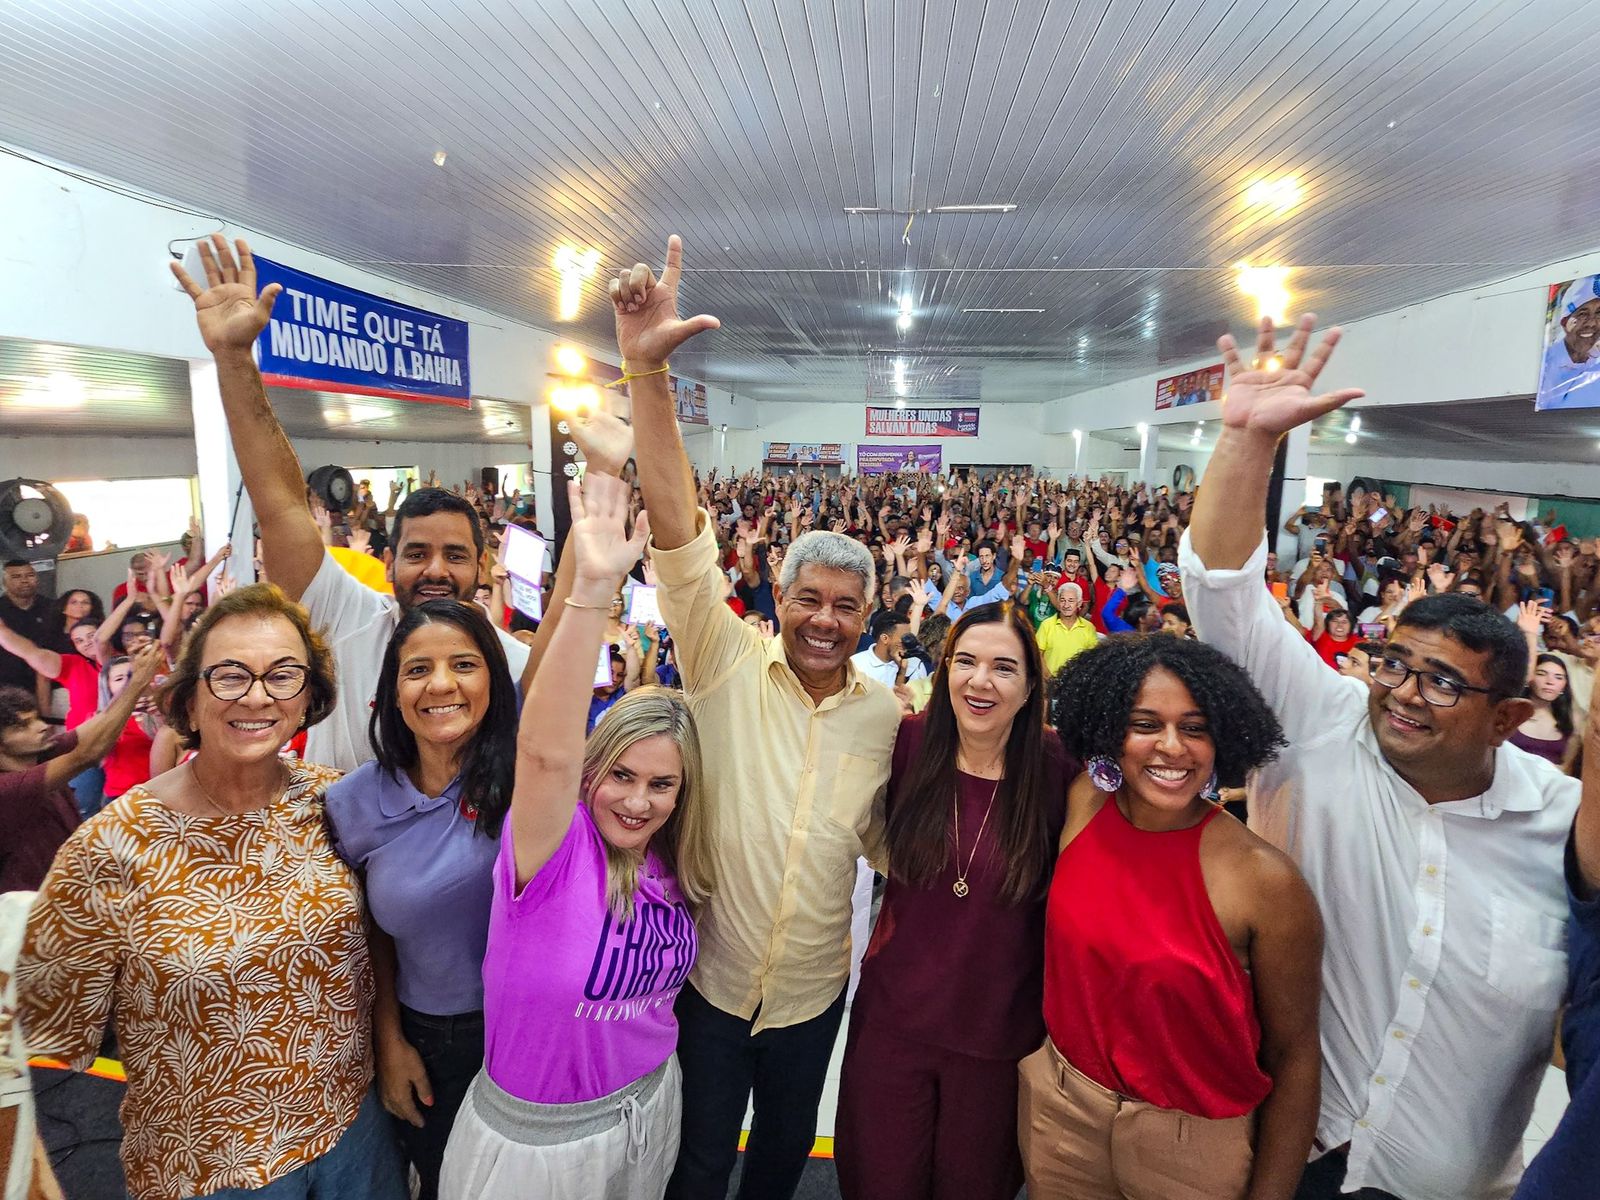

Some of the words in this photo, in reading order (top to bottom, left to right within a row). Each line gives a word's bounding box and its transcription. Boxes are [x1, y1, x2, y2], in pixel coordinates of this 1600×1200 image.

[286, 287, 359, 335] TIME
[363, 311, 415, 345] QUE
[417, 323, 445, 354] TÁ
[269, 318, 389, 375] MUDANDO
[394, 347, 407, 378] A
[410, 350, 463, 386] BAHIA
[869, 409, 917, 422] MULHERES
[918, 409, 952, 422] UNIDAS
[869, 421, 909, 434] SALVAM
[910, 422, 938, 434] VIDAS
